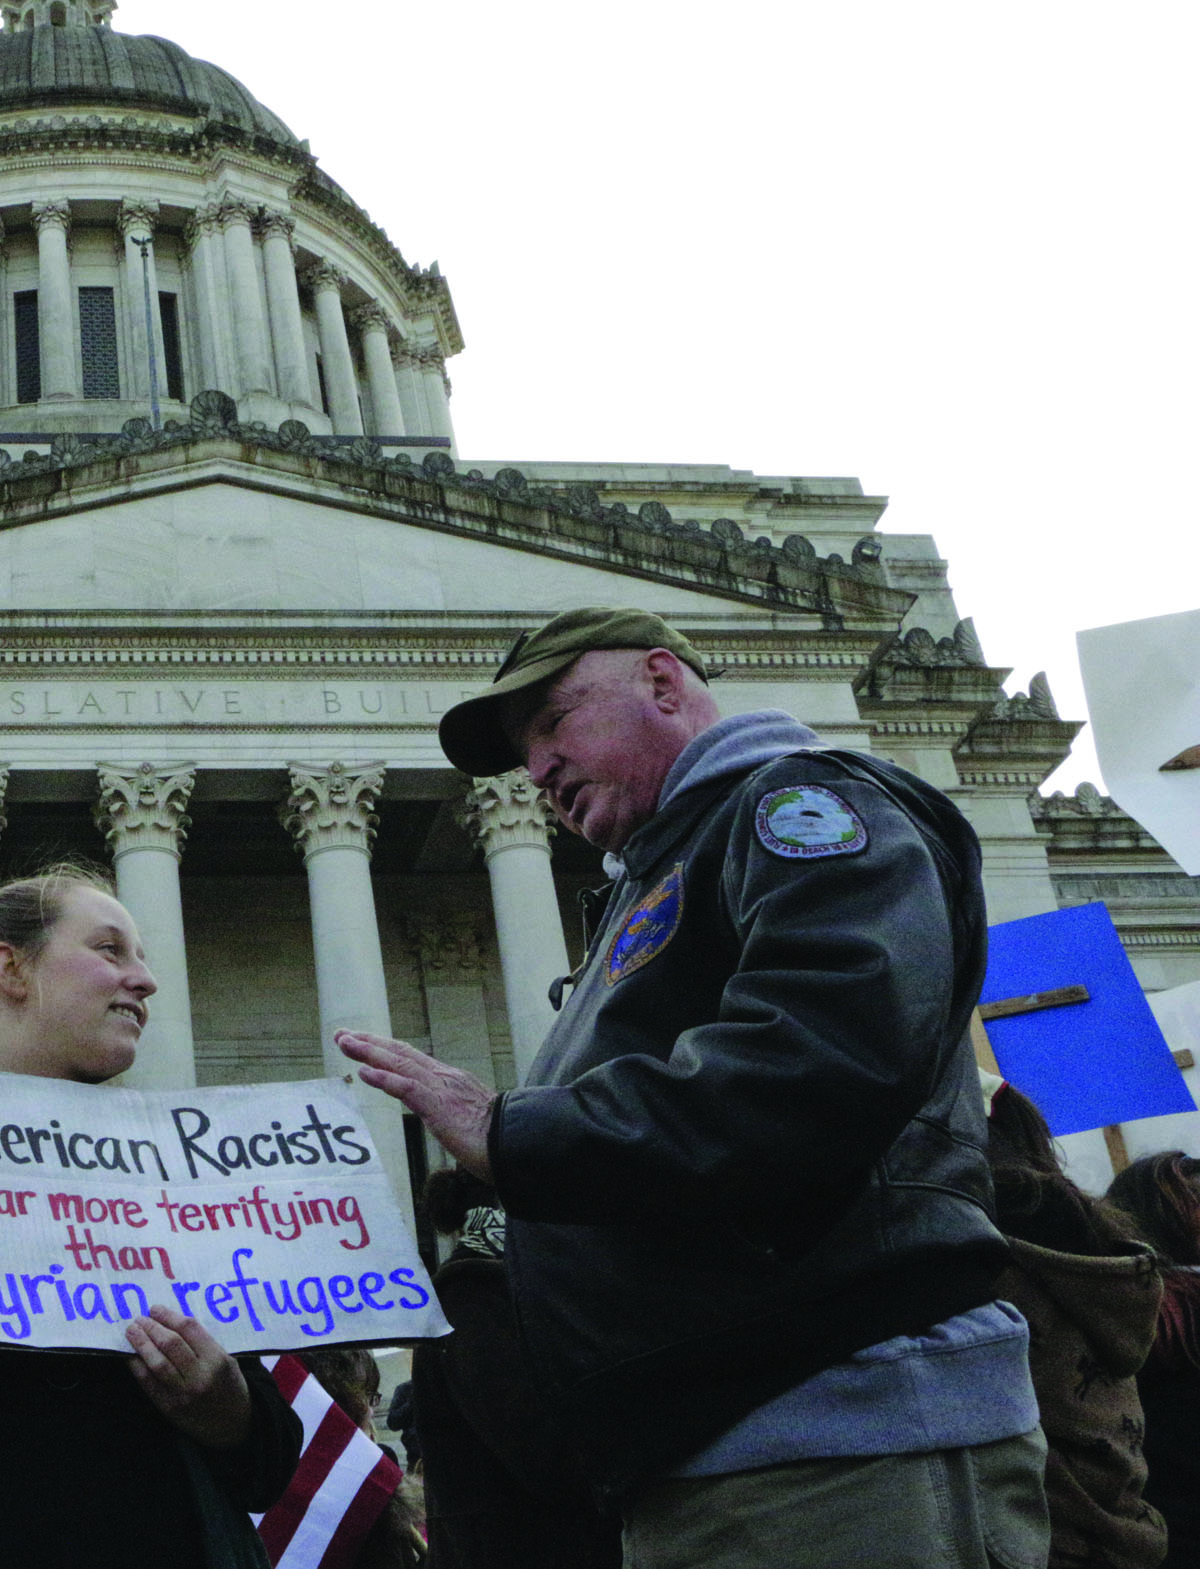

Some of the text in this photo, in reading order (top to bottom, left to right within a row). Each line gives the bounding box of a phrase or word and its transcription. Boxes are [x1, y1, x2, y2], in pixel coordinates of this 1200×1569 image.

[171, 1105, 371, 1179] Racists
[48, 1192, 148, 1229] more
[159, 1186, 370, 1250] terrifying
[65, 1225, 175, 1280] than
[176, 1248, 430, 1337] refugees
